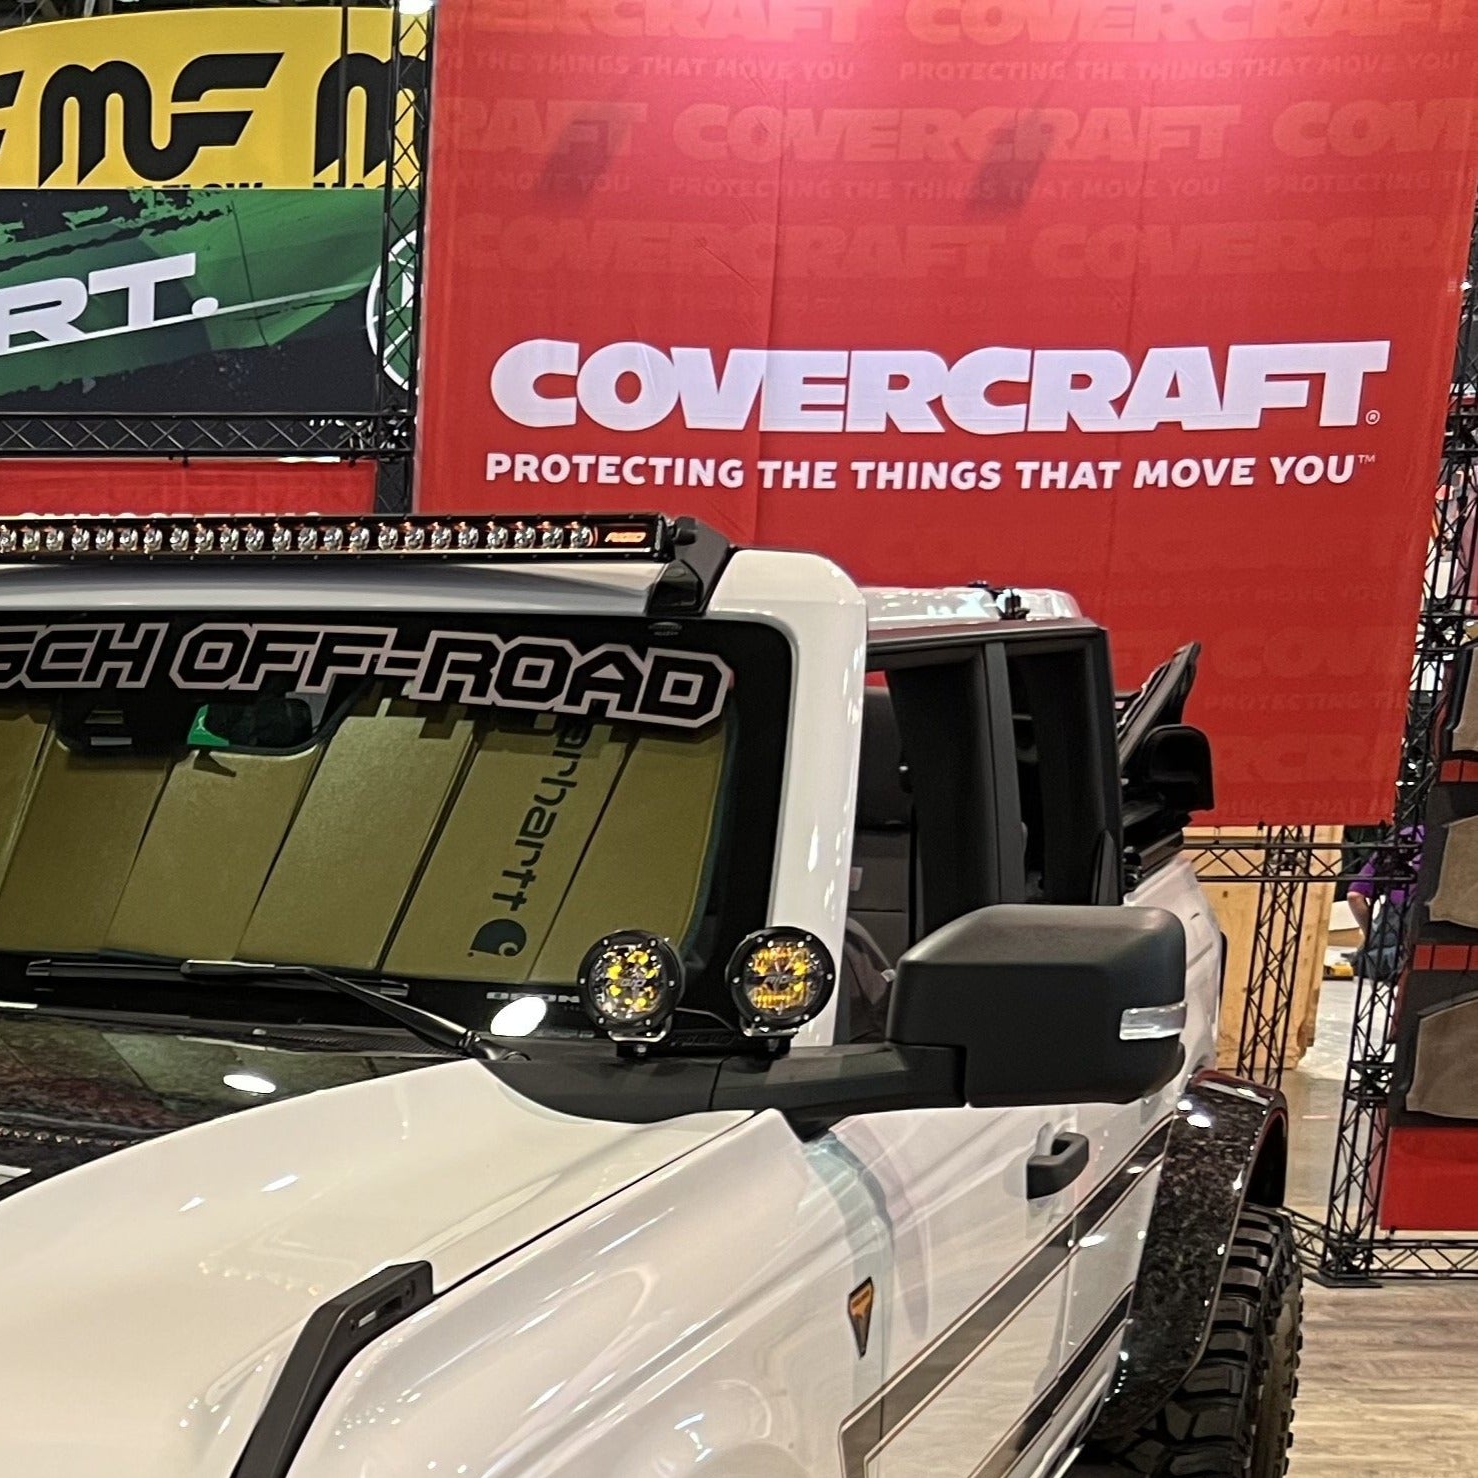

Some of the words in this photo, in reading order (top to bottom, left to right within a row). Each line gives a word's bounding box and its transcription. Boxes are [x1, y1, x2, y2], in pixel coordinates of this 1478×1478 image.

[490, 338, 1391, 434] COVERCRAFT
[486, 453, 744, 487] PROTECTING
[757, 459, 838, 490] THE
[850, 460, 1002, 491] THINGS
[1015, 461, 1121, 490] THAT
[1133, 456, 1256, 489] MOVE
[1269, 453, 1355, 485] YOU
[170, 622, 733, 729] OFF-ROAD
[492, 722, 594, 912] arhartt
